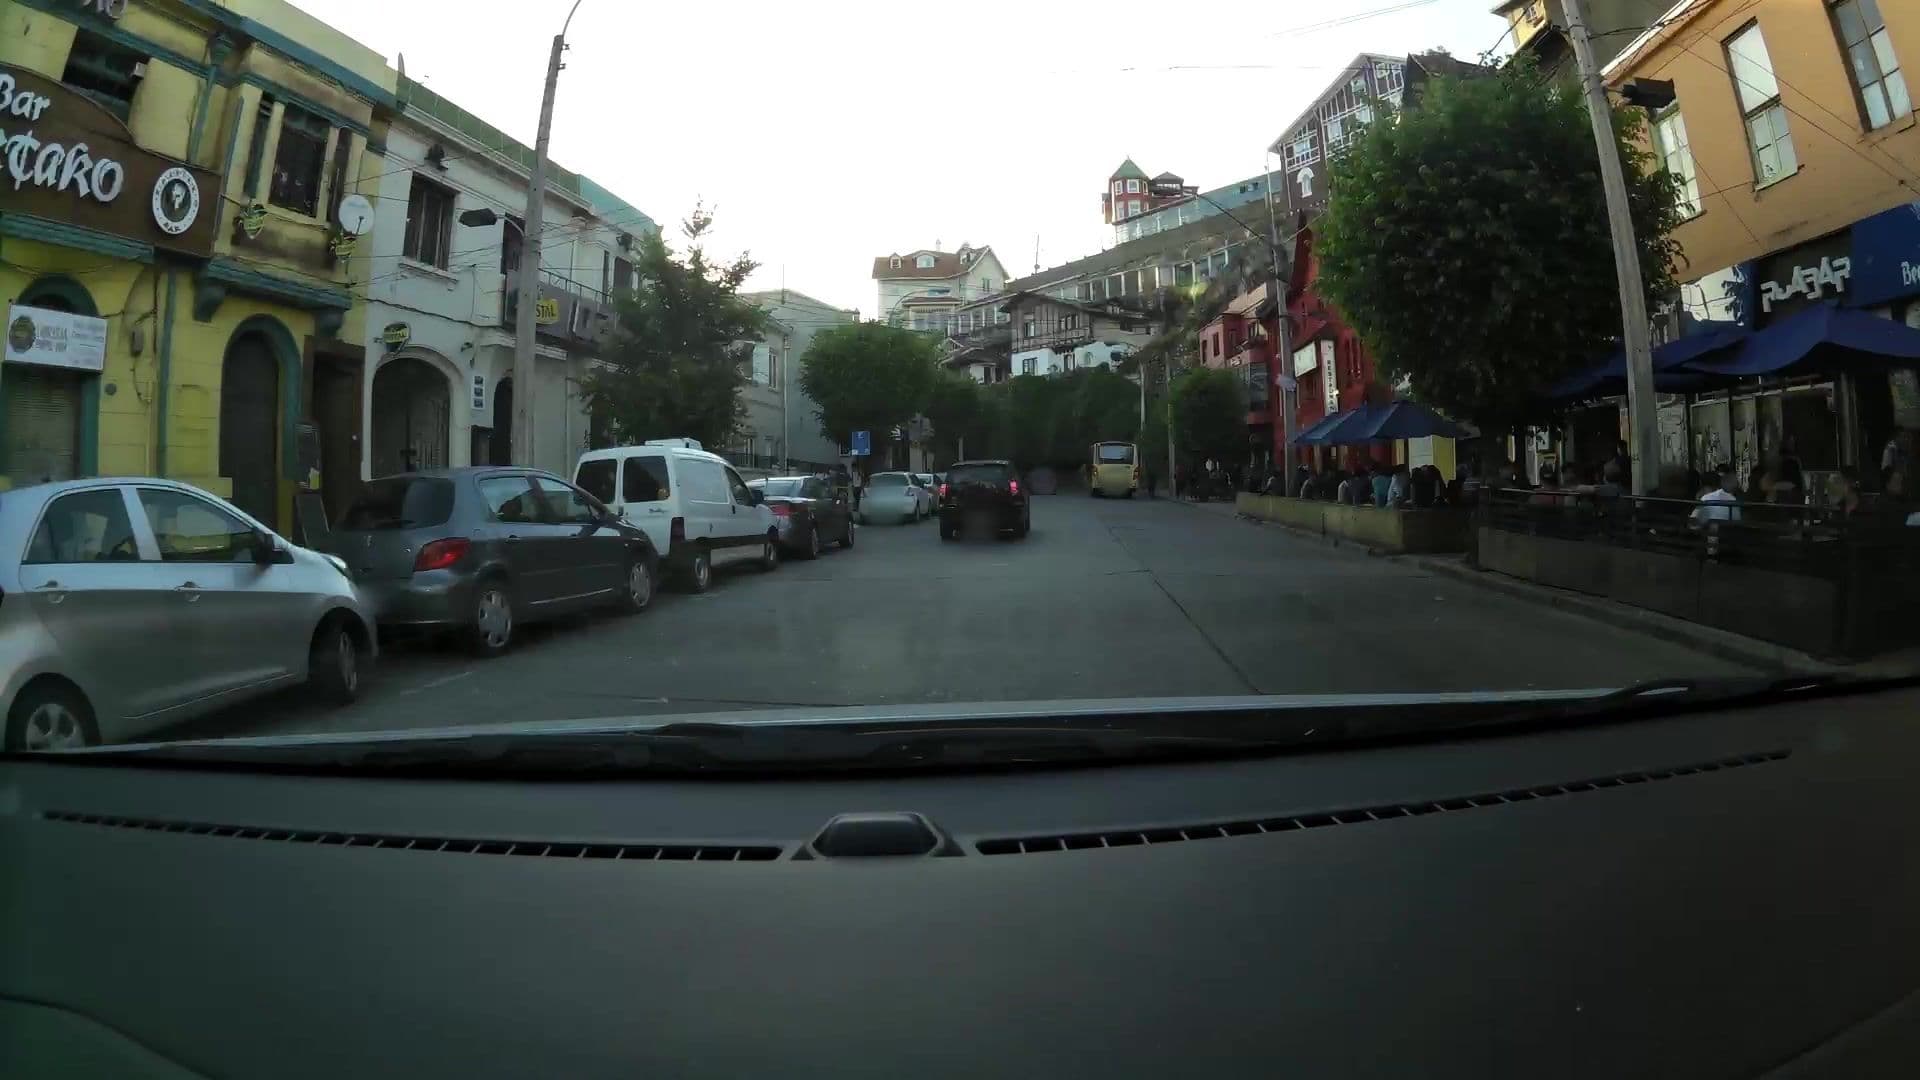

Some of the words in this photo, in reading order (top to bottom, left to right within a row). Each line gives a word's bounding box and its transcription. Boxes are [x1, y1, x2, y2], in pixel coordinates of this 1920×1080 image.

[0, 73, 50, 121] Bar
[536, 303, 557, 318] STAL
[1327, 360, 1336, 411] RESTAURAN
